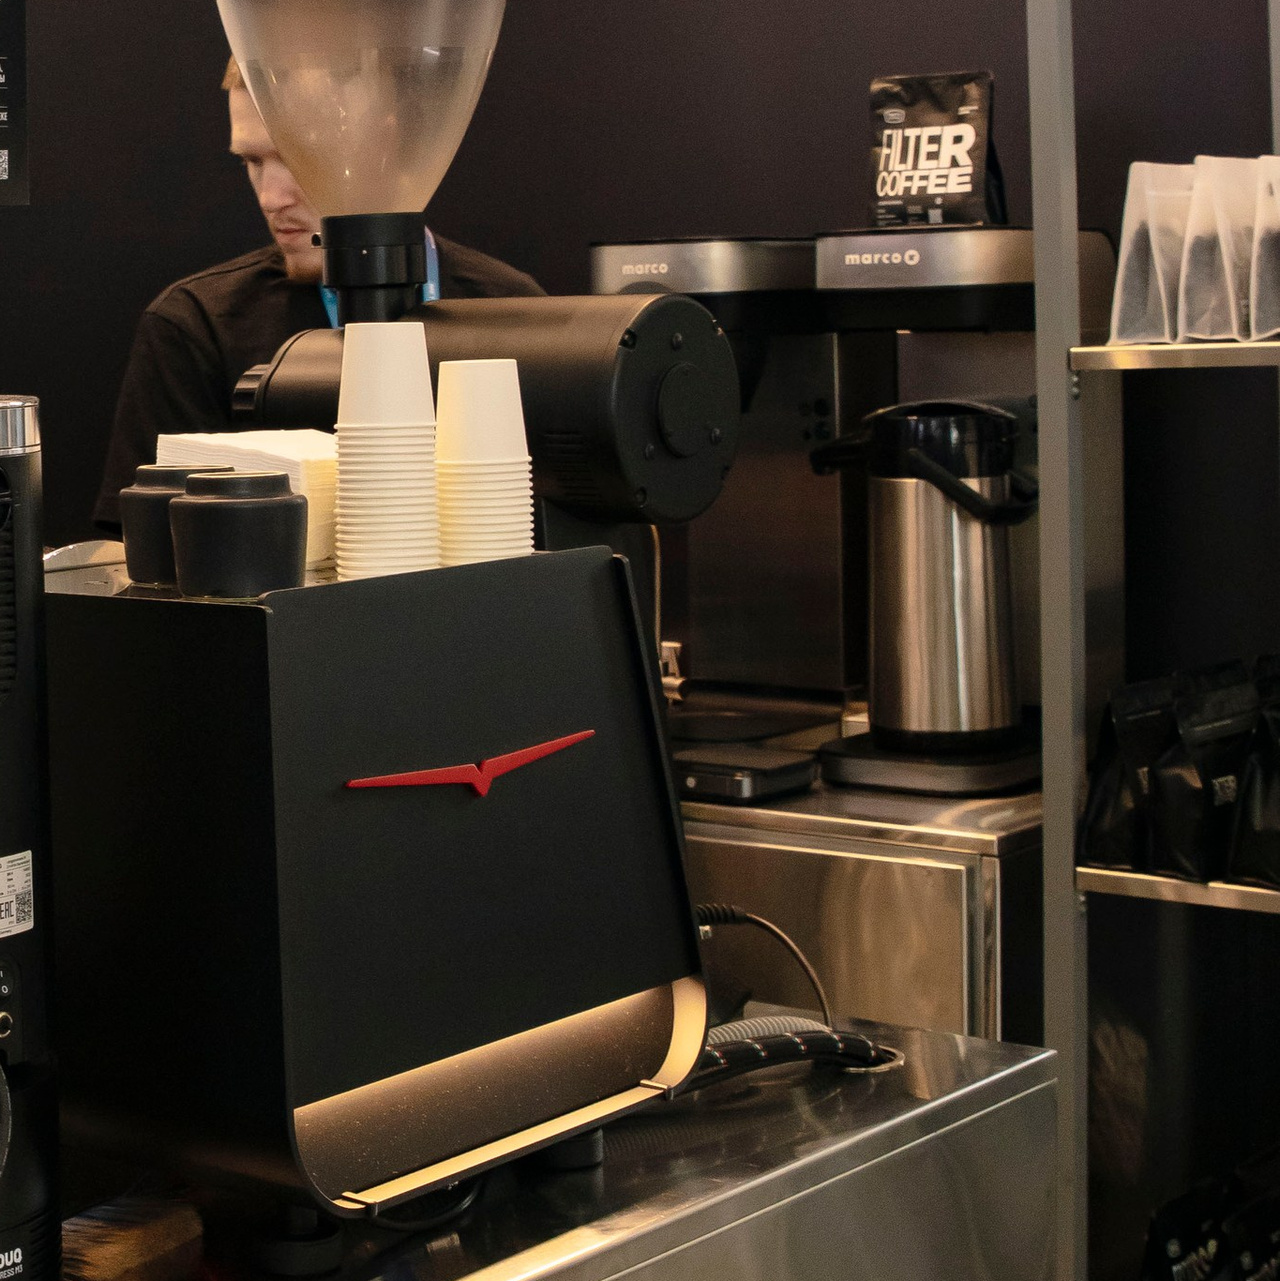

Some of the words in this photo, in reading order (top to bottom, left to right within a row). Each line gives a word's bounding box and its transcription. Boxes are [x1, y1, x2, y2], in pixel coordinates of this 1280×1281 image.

[879, 123, 976, 171] FILTER
[876, 165, 974, 197] COFFEE
[621, 262, 669, 275] marco
[844, 252, 902, 266] marco
